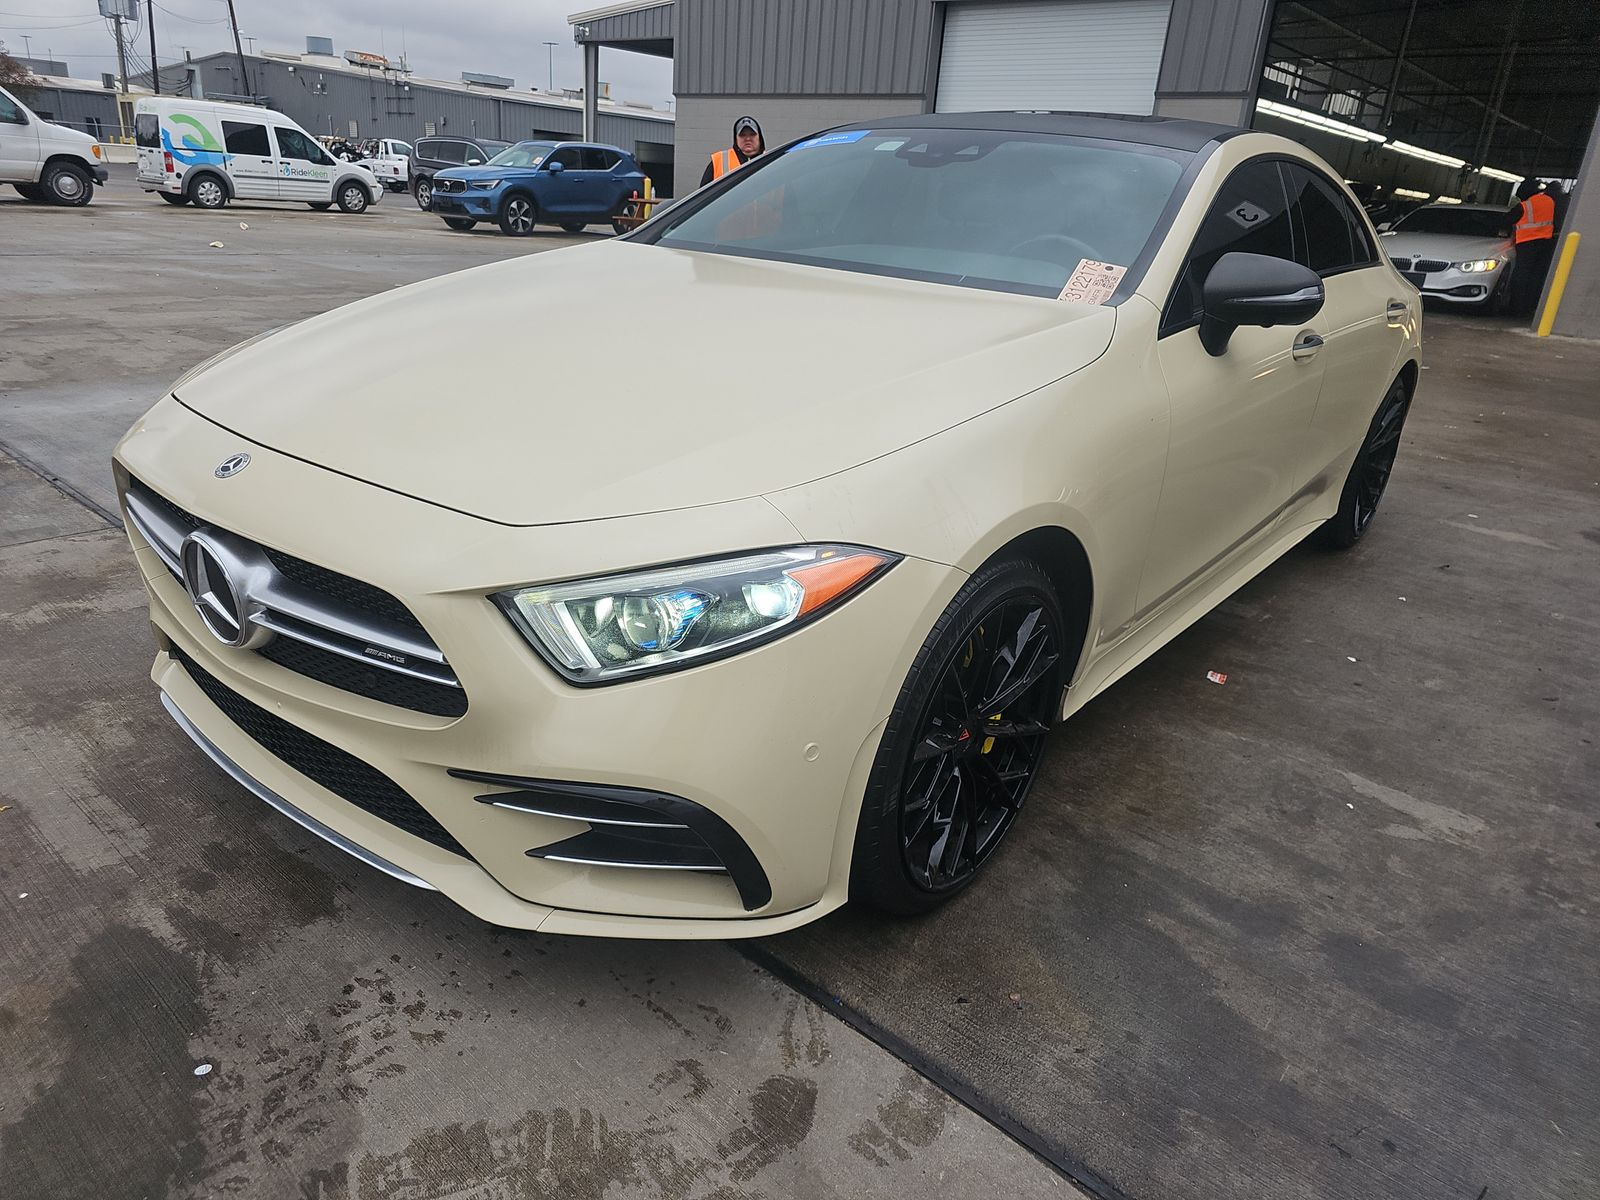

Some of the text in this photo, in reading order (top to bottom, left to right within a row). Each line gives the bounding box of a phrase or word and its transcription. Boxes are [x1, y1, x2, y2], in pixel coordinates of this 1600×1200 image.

[291, 168, 328, 178] RideKleen
[1060, 260, 1101, 302] 3122179
[377, 651, 405, 664] AMG
